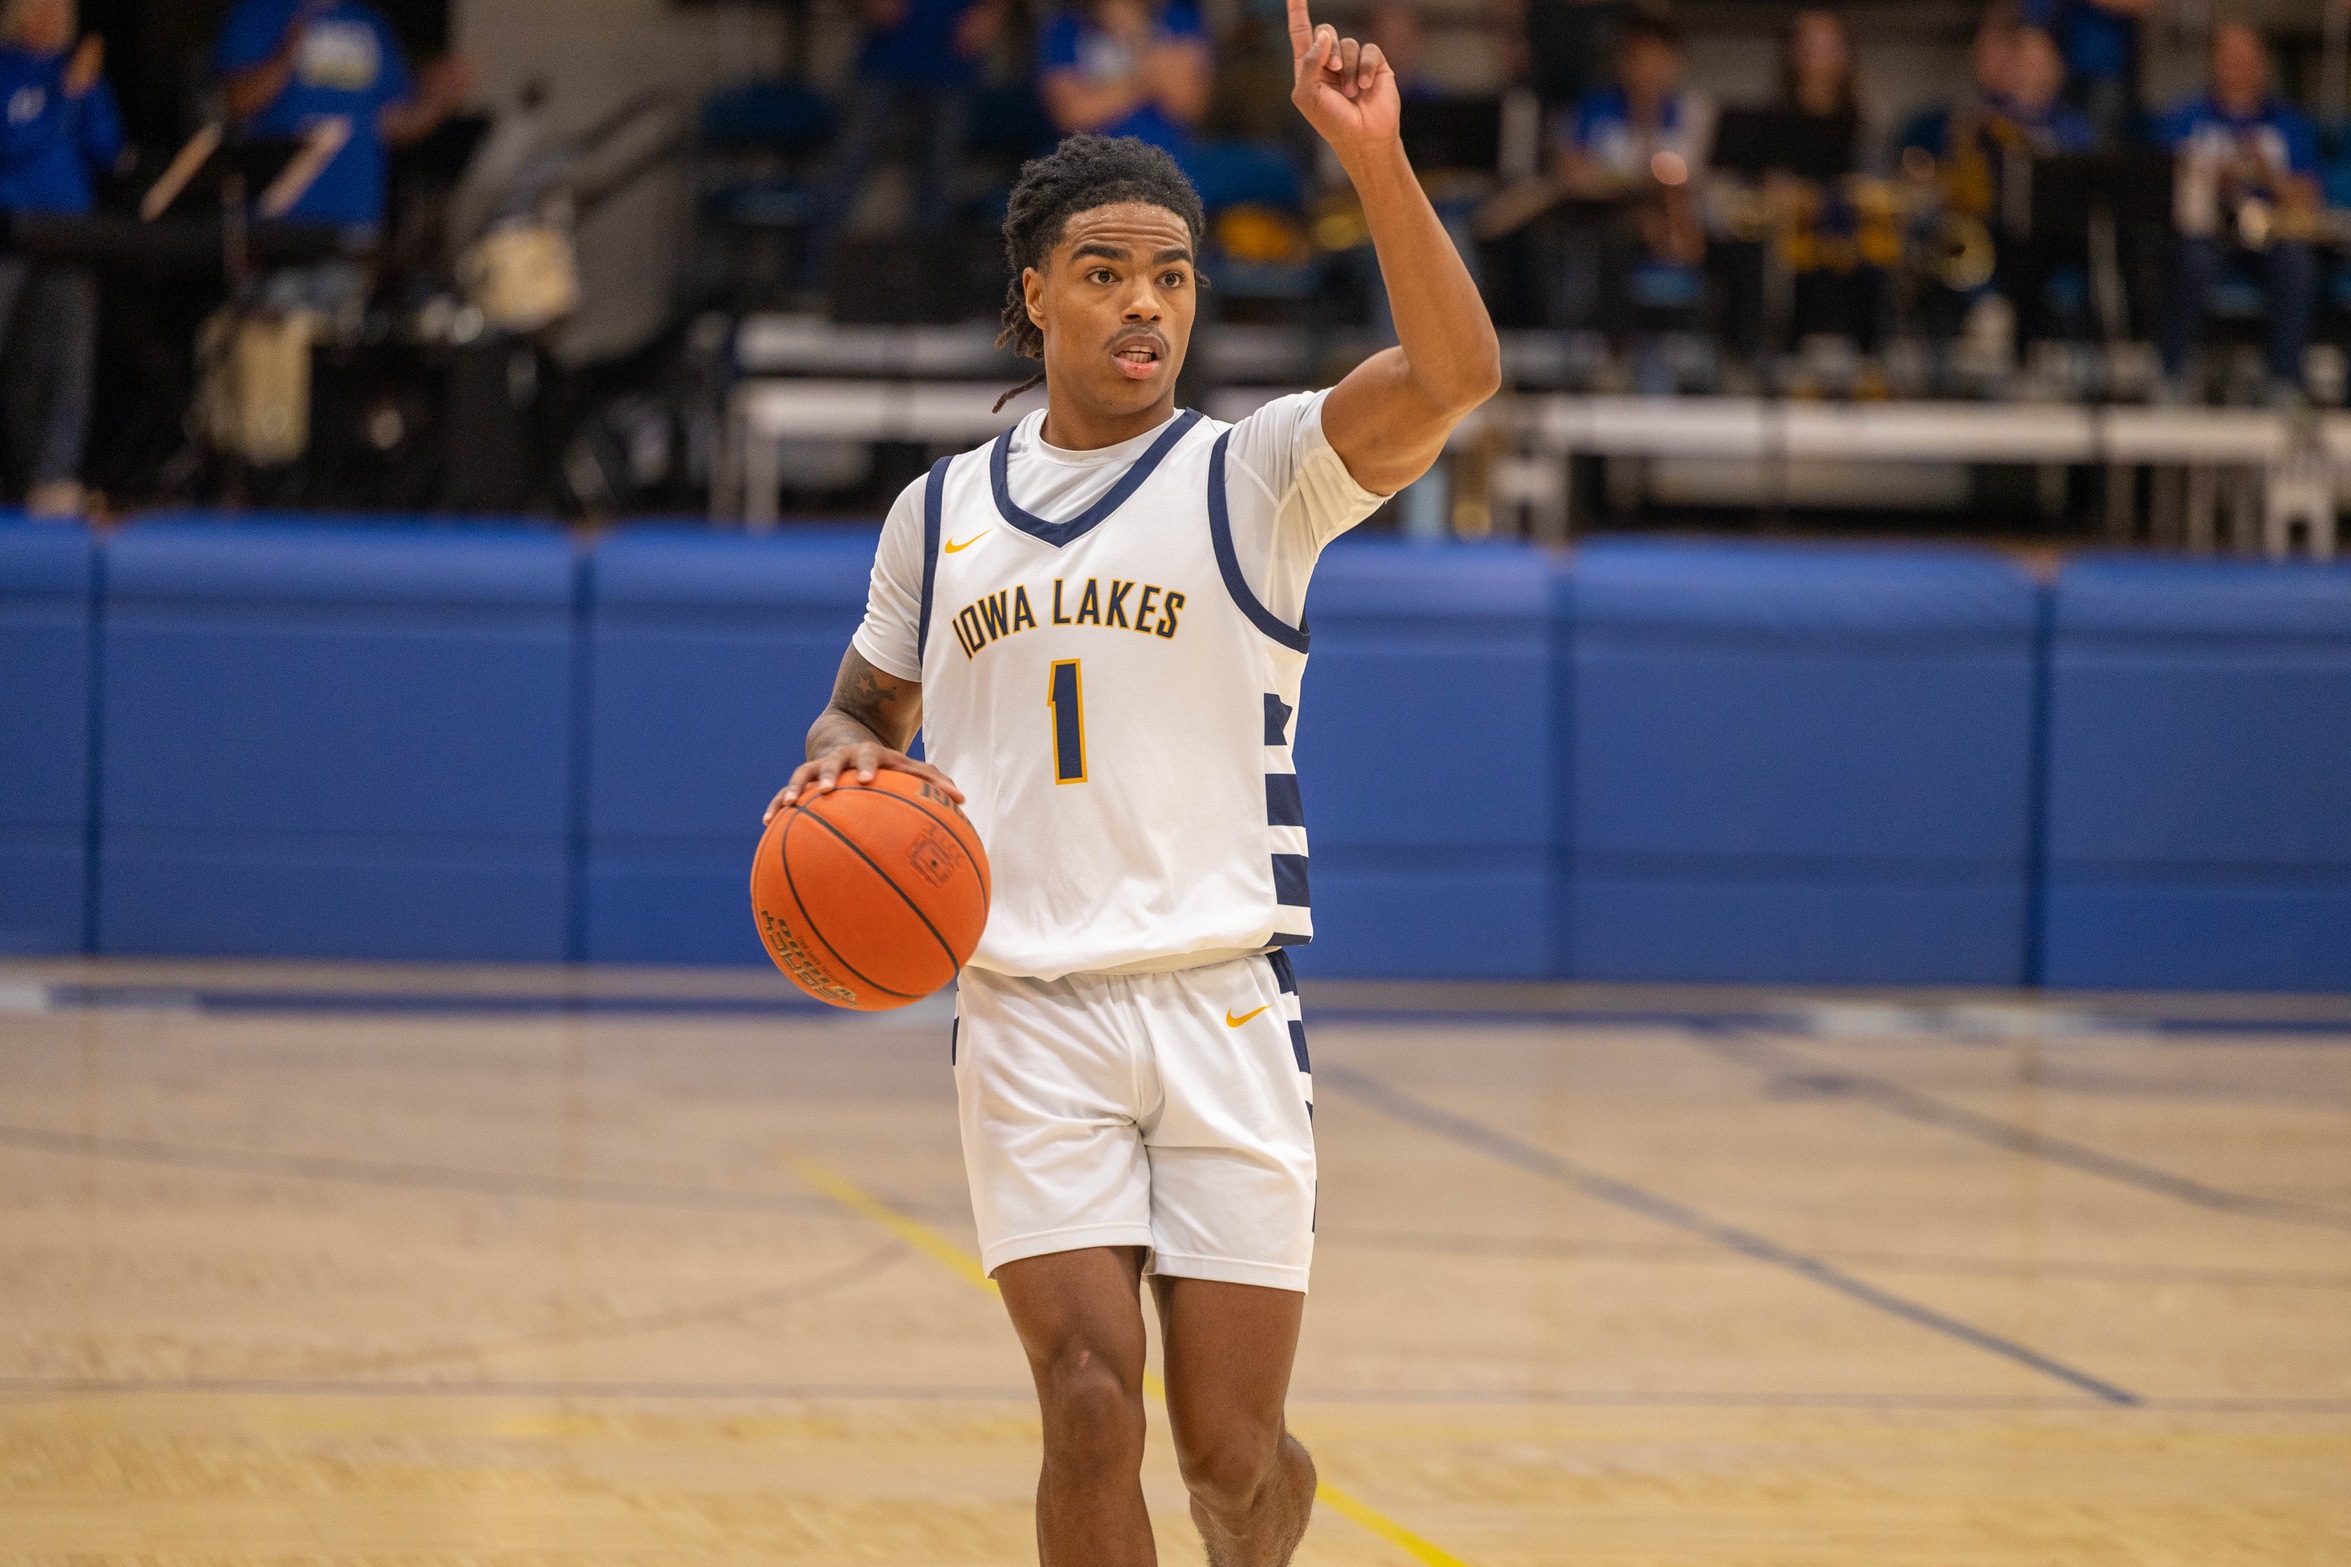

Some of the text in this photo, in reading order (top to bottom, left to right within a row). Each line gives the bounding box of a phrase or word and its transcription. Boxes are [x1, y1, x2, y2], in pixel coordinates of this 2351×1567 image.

[952, 578, 1186, 661] IOWA LAKES
[1047, 658, 1088, 785] 1
[762, 910, 858, 1006] LEGACY
